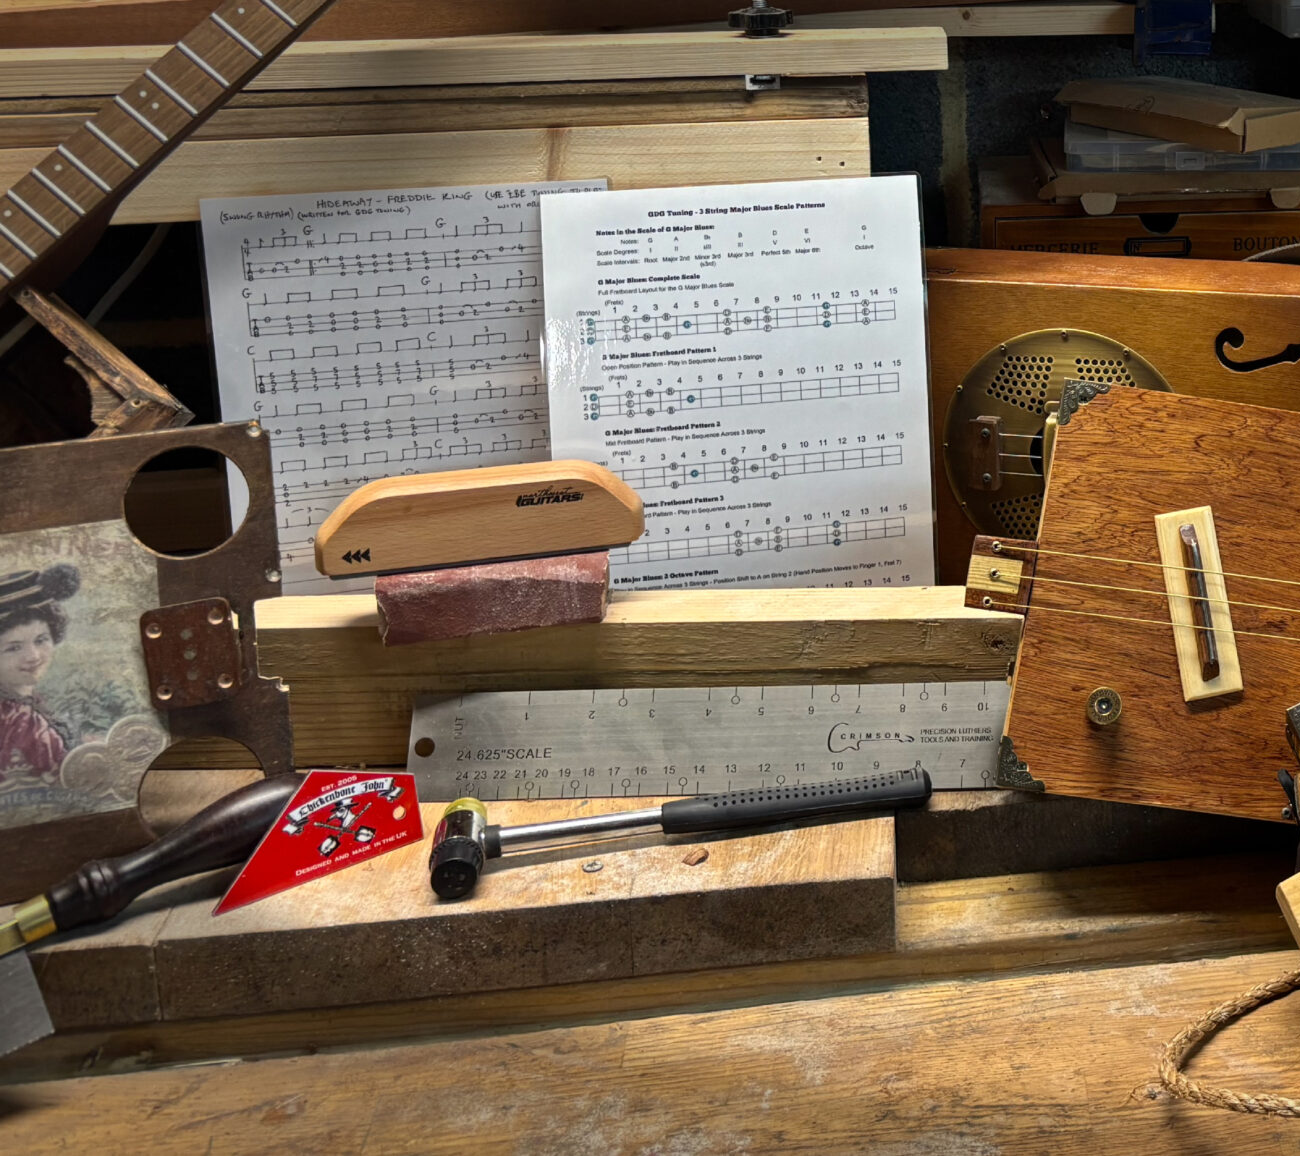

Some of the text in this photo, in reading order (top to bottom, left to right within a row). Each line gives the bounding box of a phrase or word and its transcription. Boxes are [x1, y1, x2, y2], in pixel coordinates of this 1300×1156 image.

[442, 192, 473, 201] KING
[648, 210, 665, 218] GDG
[667, 210, 694, 218] Tuning
[705, 207, 728, 216] String
[729, 205, 751, 214] Major
[752, 204, 773, 212] Blues
[774, 203, 795, 211] Scale
[795, 202, 826, 210] Patterns
[302, 218, 447, 235] G G
[672, 225, 693, 233] Major
[854, 243, 874, 251] Octave
[604, 278, 625, 286] Major
[648, 275, 681, 284] Complete
[241, 276, 431, 298] G G
[638, 286, 658, 294] Layout
[684, 283, 701, 292] Major
[713, 299, 719, 307] 6
[831, 291, 840, 299] 12
[889, 287, 898, 295] 15
[652, 349, 685, 357] Fretboard
[686, 347, 711, 355] Pattern
[429, 385, 440, 396] G
[612, 428, 633, 436] Major
[656, 424, 689, 433] Fretboard
[690, 422, 715, 430] Pattern
[659, 499, 693, 507] Fretboard
[694, 496, 719, 504] Pattern
[694, 568, 719, 577] Pattern
[453, 716, 466, 740] NUT
[920, 727, 992, 736] PRECISION LUTHIERS
[840, 732, 901, 740] CRIMSON
[920, 736, 944, 744] TOOLS
[455, 758, 966, 782] 24 23 22 21 20 19 18 17 16 15 14 13 12 11 10 9 7
[337, 775, 358, 787] 2005
[334, 853, 350, 862] AND
[352, 844, 372, 856] MADE
[381, 836, 396, 845] THE
[395, 831, 408, 840] UK
